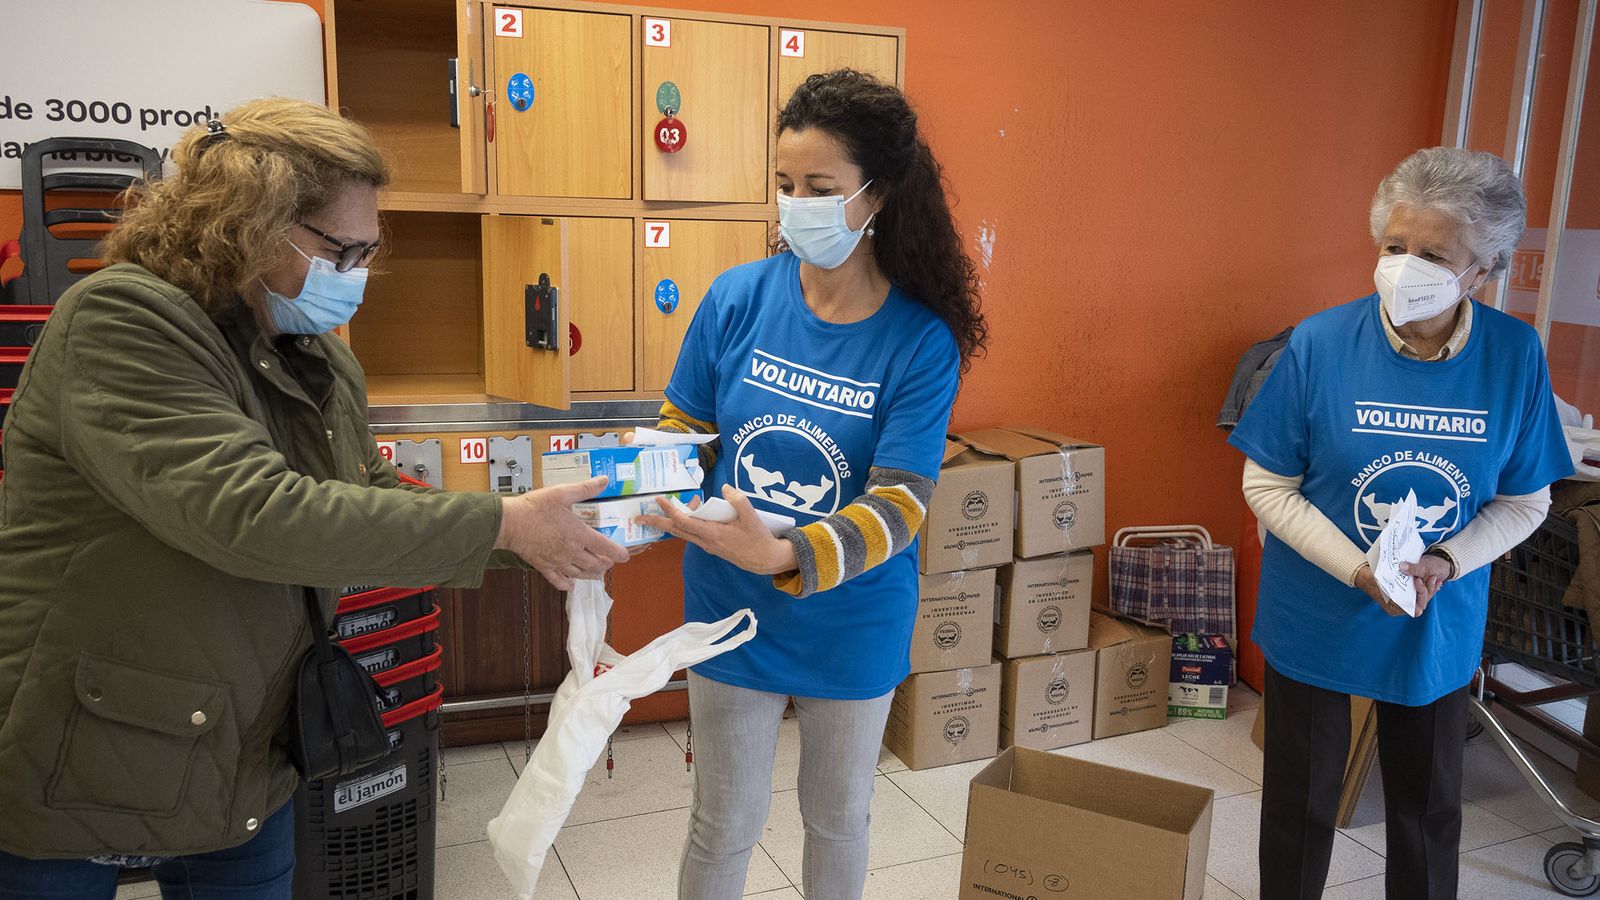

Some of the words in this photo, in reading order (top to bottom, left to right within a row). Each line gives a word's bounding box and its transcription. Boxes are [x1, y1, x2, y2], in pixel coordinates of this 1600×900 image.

[502, 14, 517, 33] 2
[651, 24, 665, 42] 3
[786, 36, 799, 53] 4
[0, 96, 33, 120] de
[45, 98, 132, 124] 3000
[140, 105, 219, 131] prod
[660, 128, 680, 145] 03
[650, 227, 665, 243] 7
[751, 357, 875, 409] VOLUNTARIO
[1356, 409, 1486, 435] VOLUNTARIO
[377, 445, 393, 462] 9
[463, 442, 484, 459] 10
[552, 439, 575, 451] 11
[732, 414, 773, 445] BANCO
[777, 413, 797, 426] DE
[797, 418, 851, 479] ALIMENTOS
[1351, 454, 1392, 488] BANCO
[1394, 451, 1413, 462] DE
[1416, 451, 1471, 499] ALIMENTOS
[967, 538, 1000, 546] INTERNATIONAL
[338, 789, 352, 805] el
[356, 771, 404, 802] jamón
[973, 883, 1024, 900] INTERNATIONAL
